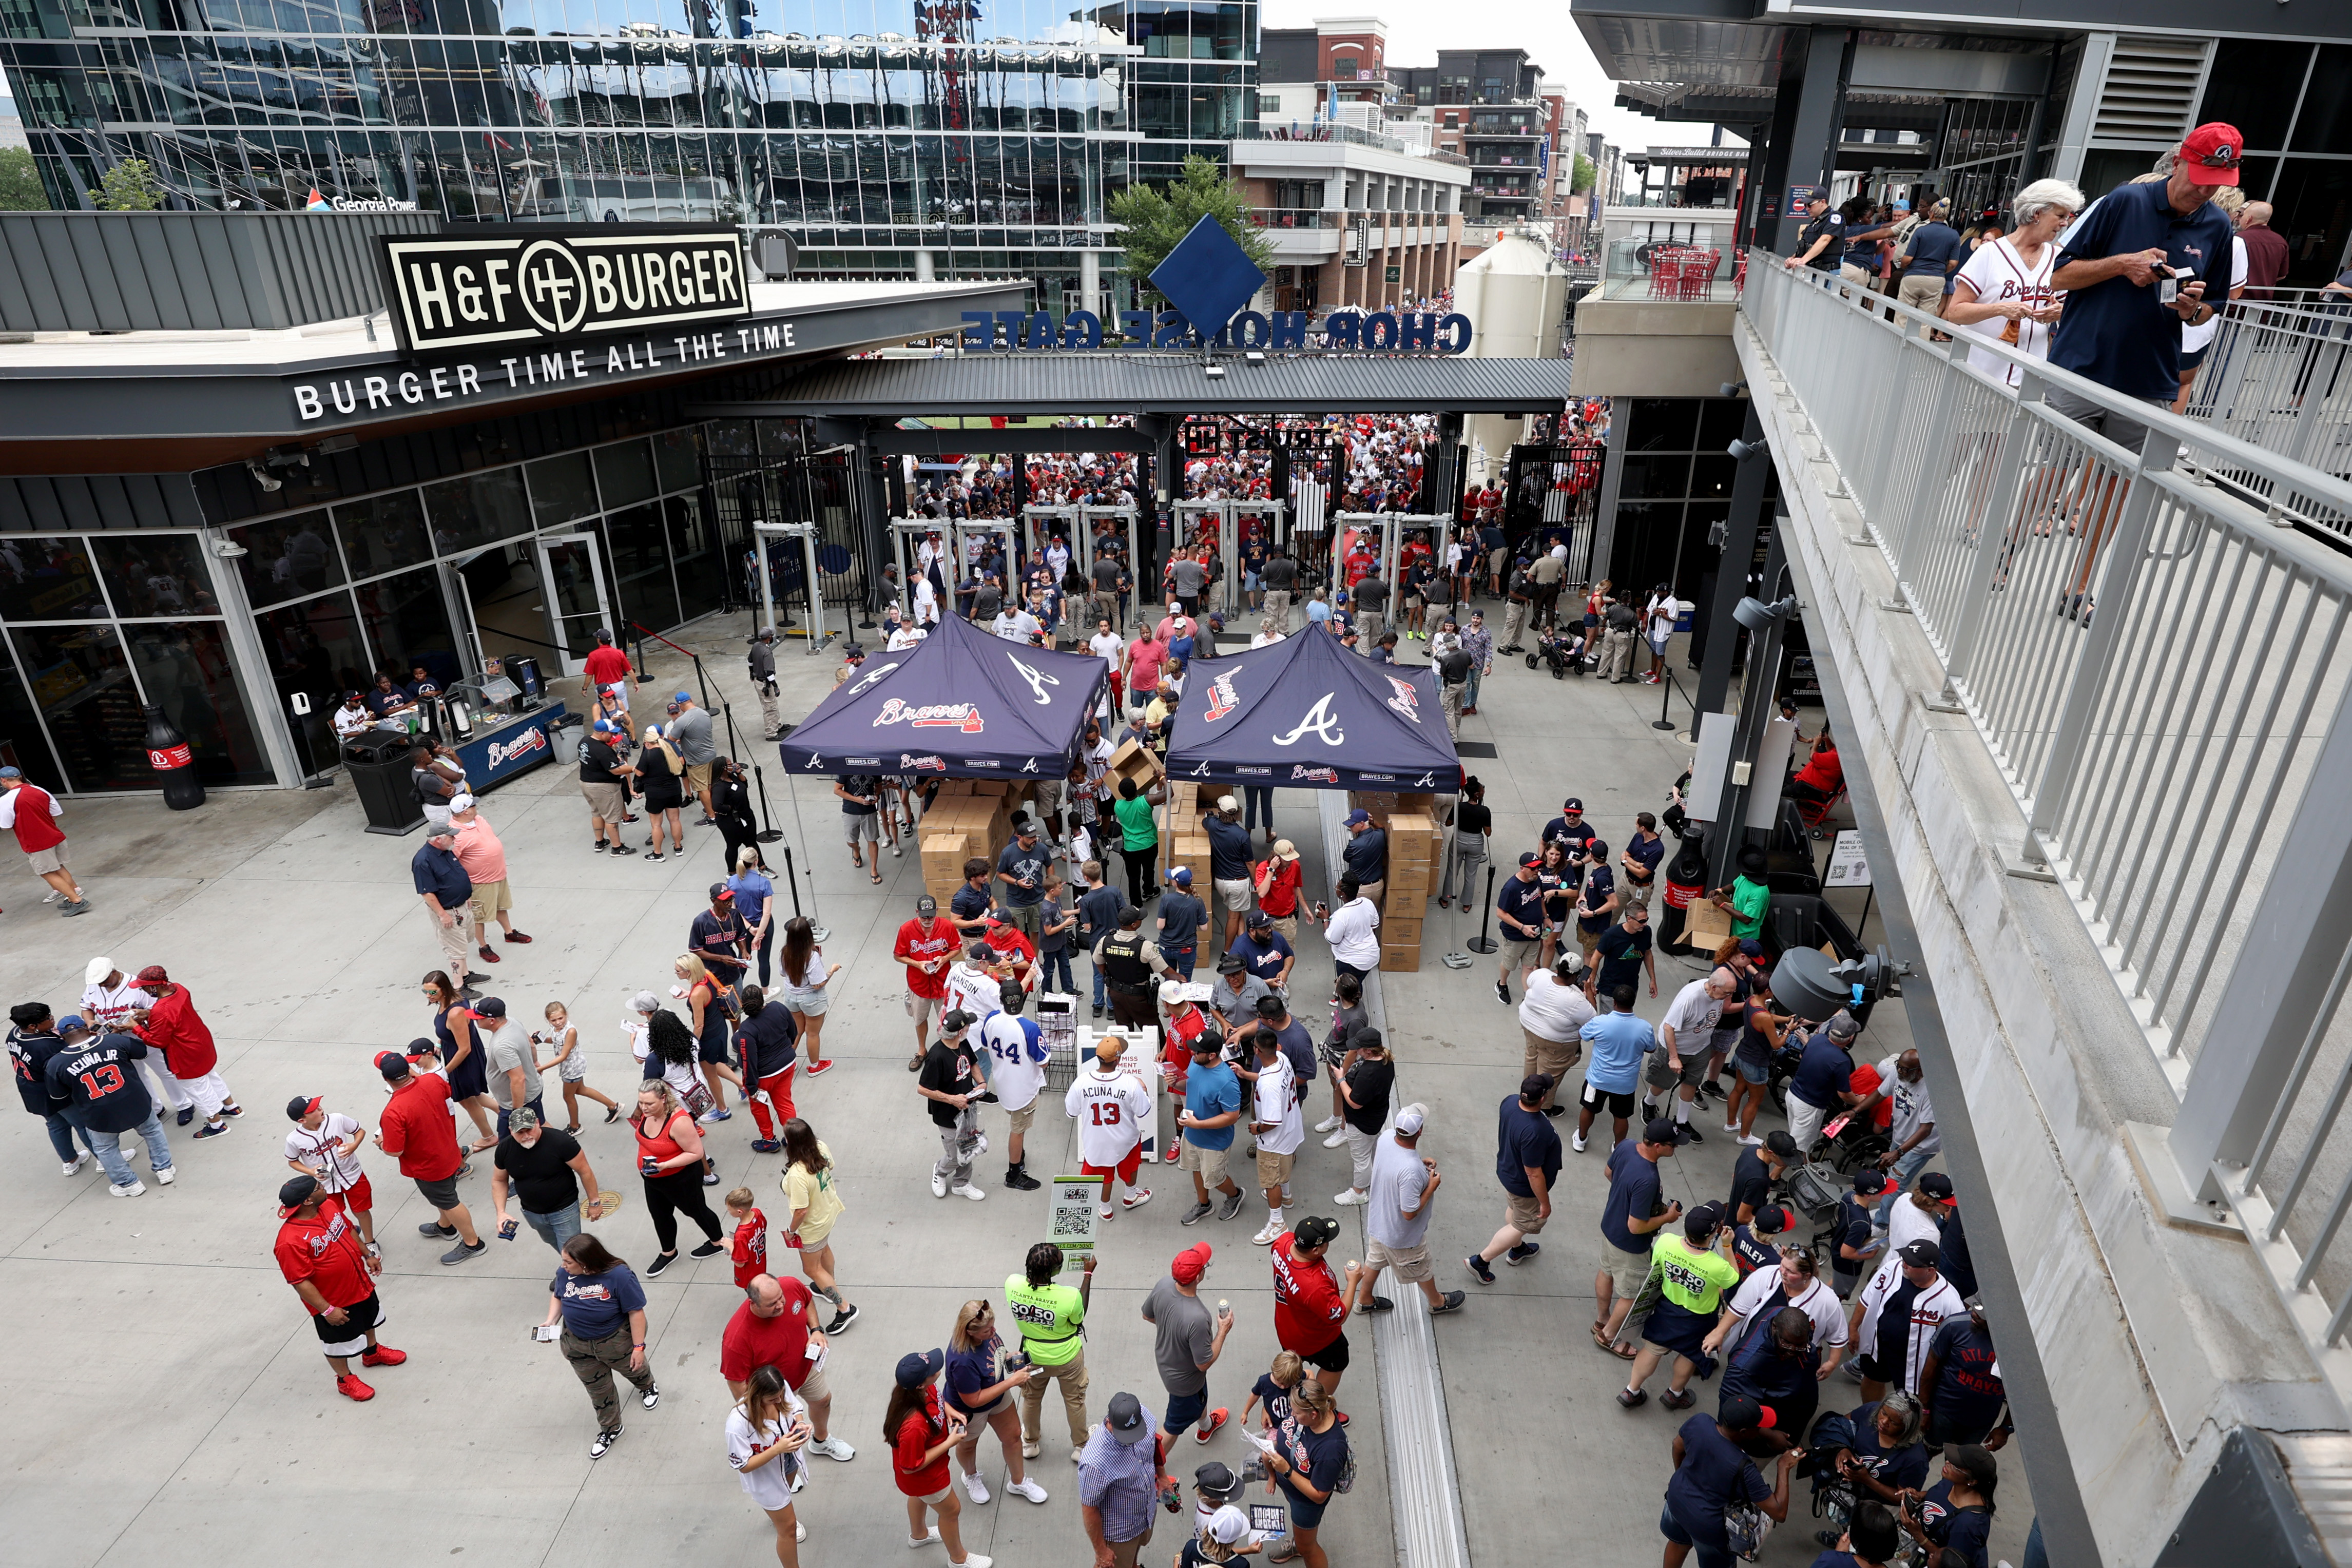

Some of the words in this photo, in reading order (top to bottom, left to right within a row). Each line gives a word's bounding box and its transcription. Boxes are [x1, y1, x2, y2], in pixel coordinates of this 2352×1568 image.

[1661, 147, 1683, 156] Silver
[1684, 147, 1705, 156] Bullet
[332, 196, 387, 211] Georgia
[388, 196, 416, 211] Power
[411, 259, 512, 330] H&F
[588, 249, 738, 313] BURGER
[2000, 279, 2053, 300] Braves
[294, 364, 481, 420] BURGER
[500, 350, 589, 387] TIME
[608, 342, 661, 373] ALL
[674, 332, 726, 362] THE
[738, 323, 795, 353] TIME
[873, 698, 970, 727] Braves
[1273, 692, 1344, 746] A
[488, 726, 534, 770] Braves
[805, 752, 823, 769] A
[900, 753, 937, 769] Braves
[1019, 757, 1039, 773] A
[1190, 760, 1211, 777] A
[1291, 764, 1332, 780] Braves
[1414, 770, 1435, 787] A
[909, 937, 942, 954] Braves
[1106, 947, 1135, 957] SHERIFF
[1257, 950, 1278, 967] Braves
[955, 991, 965, 1010] 7
[67, 1052, 102, 1077] ACUÑA
[103, 1049, 119, 1062] JR.
[991, 1037, 1020, 1065] 44
[80, 1064, 125, 1100] 13
[1084, 1080, 1113, 1098] ACUÑA
[1113, 1089, 1126, 1100] JR.
[1086, 1102, 1121, 1126] 13
[311, 1213, 343, 1257] Braves
[1666, 1251, 1686, 1266] ATLANTA
[1684, 1261, 1708, 1275] BRAVES
[1739, 1240, 1766, 1264] RILEY
[1272, 1249, 1300, 1295] FREEMAN
[564, 1282, 603, 1298] Braves
[1011, 1289, 1034, 1301] ATLANTA
[1035, 1297, 1058, 1305] BRAVES
[1275, 1274, 1289, 1305] 5
[1960, 1348, 1996, 1363] ATLA
[1957, 1369, 2003, 1396] BRAVE
